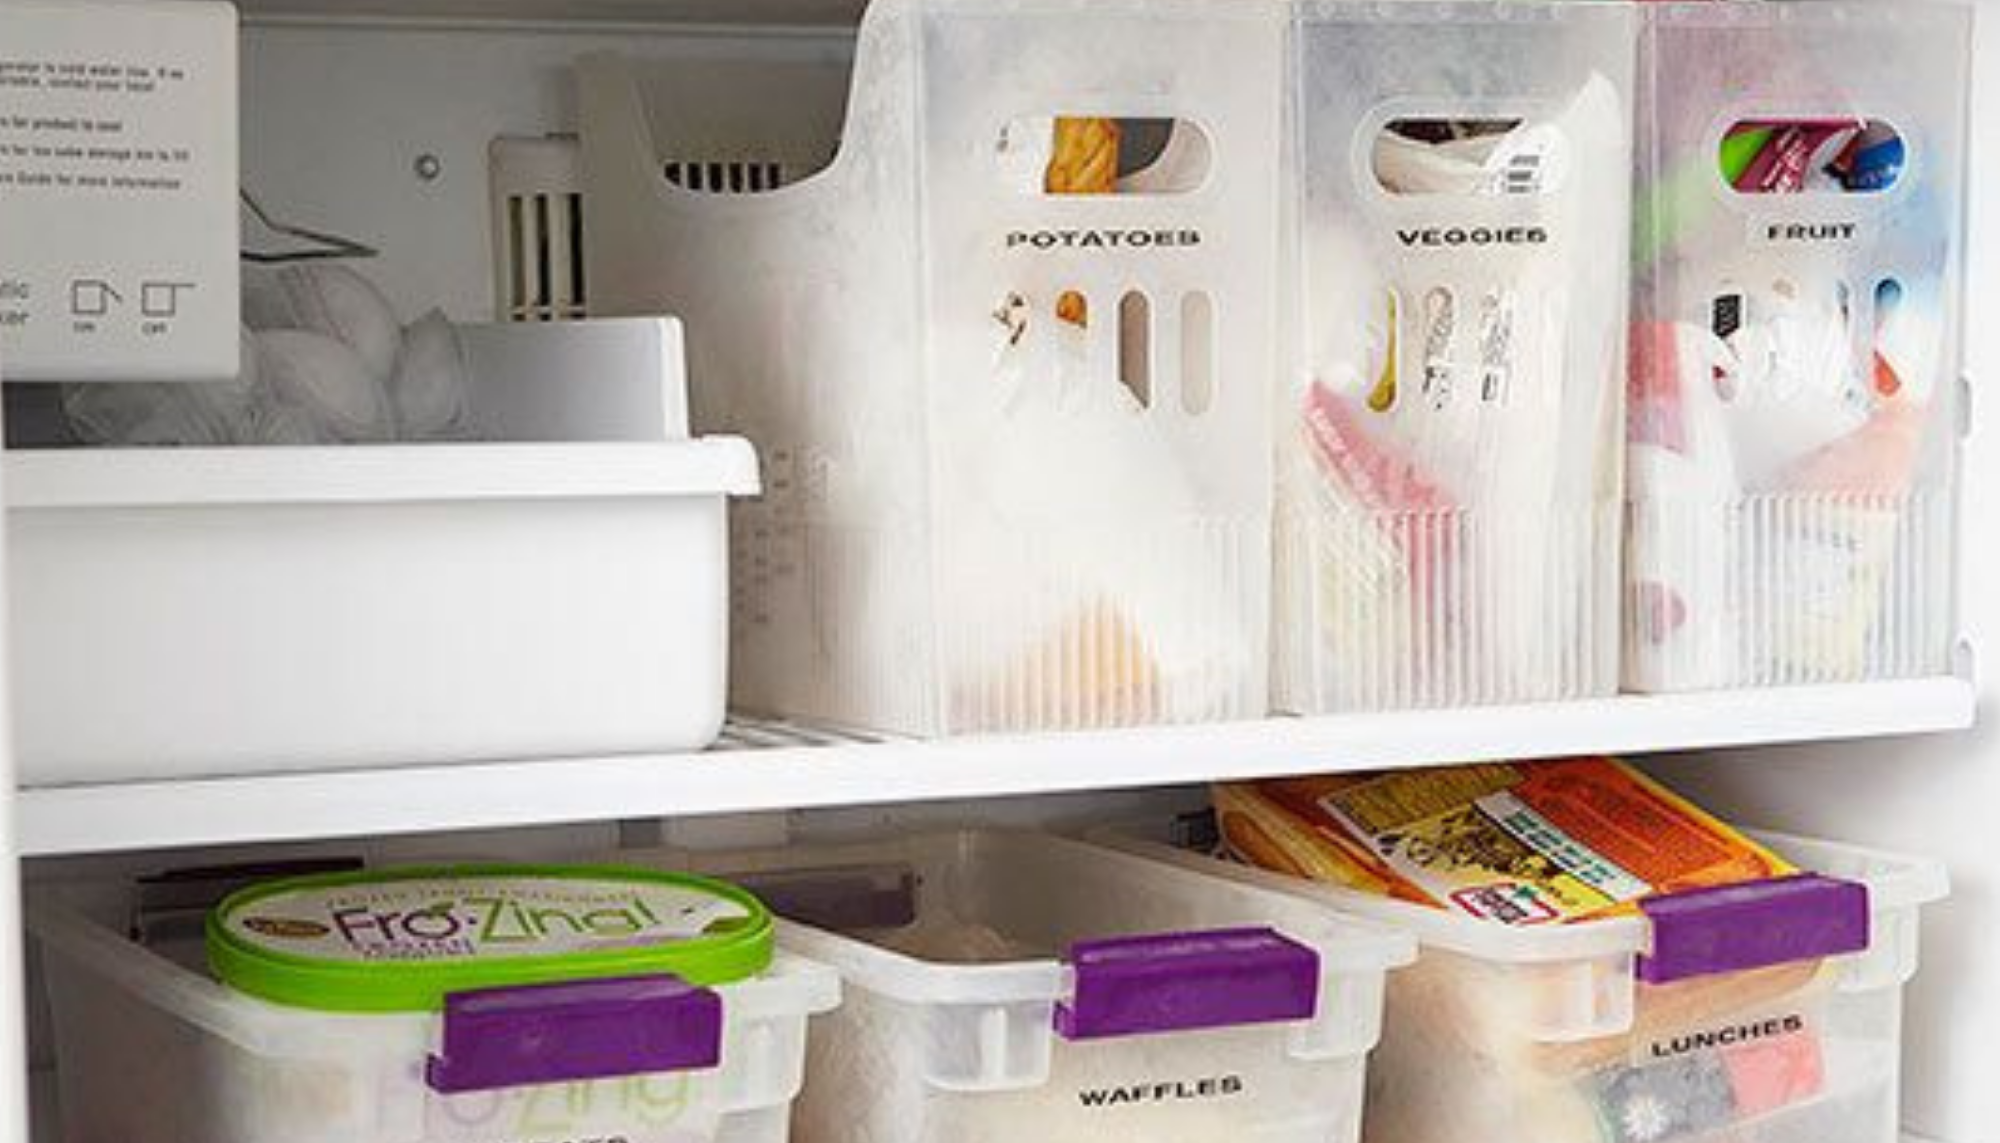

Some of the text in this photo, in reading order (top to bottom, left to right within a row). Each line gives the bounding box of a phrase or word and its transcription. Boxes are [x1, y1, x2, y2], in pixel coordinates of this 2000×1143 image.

[1005, 230, 1201, 247] POTATOES
[1397, 229, 1548, 246] VEGGIES
[1767, 223, 1856, 239] FRUIT
[1651, 1014, 1803, 1057] LUNCHES
[1079, 1074, 1243, 1107] WAFFLES
